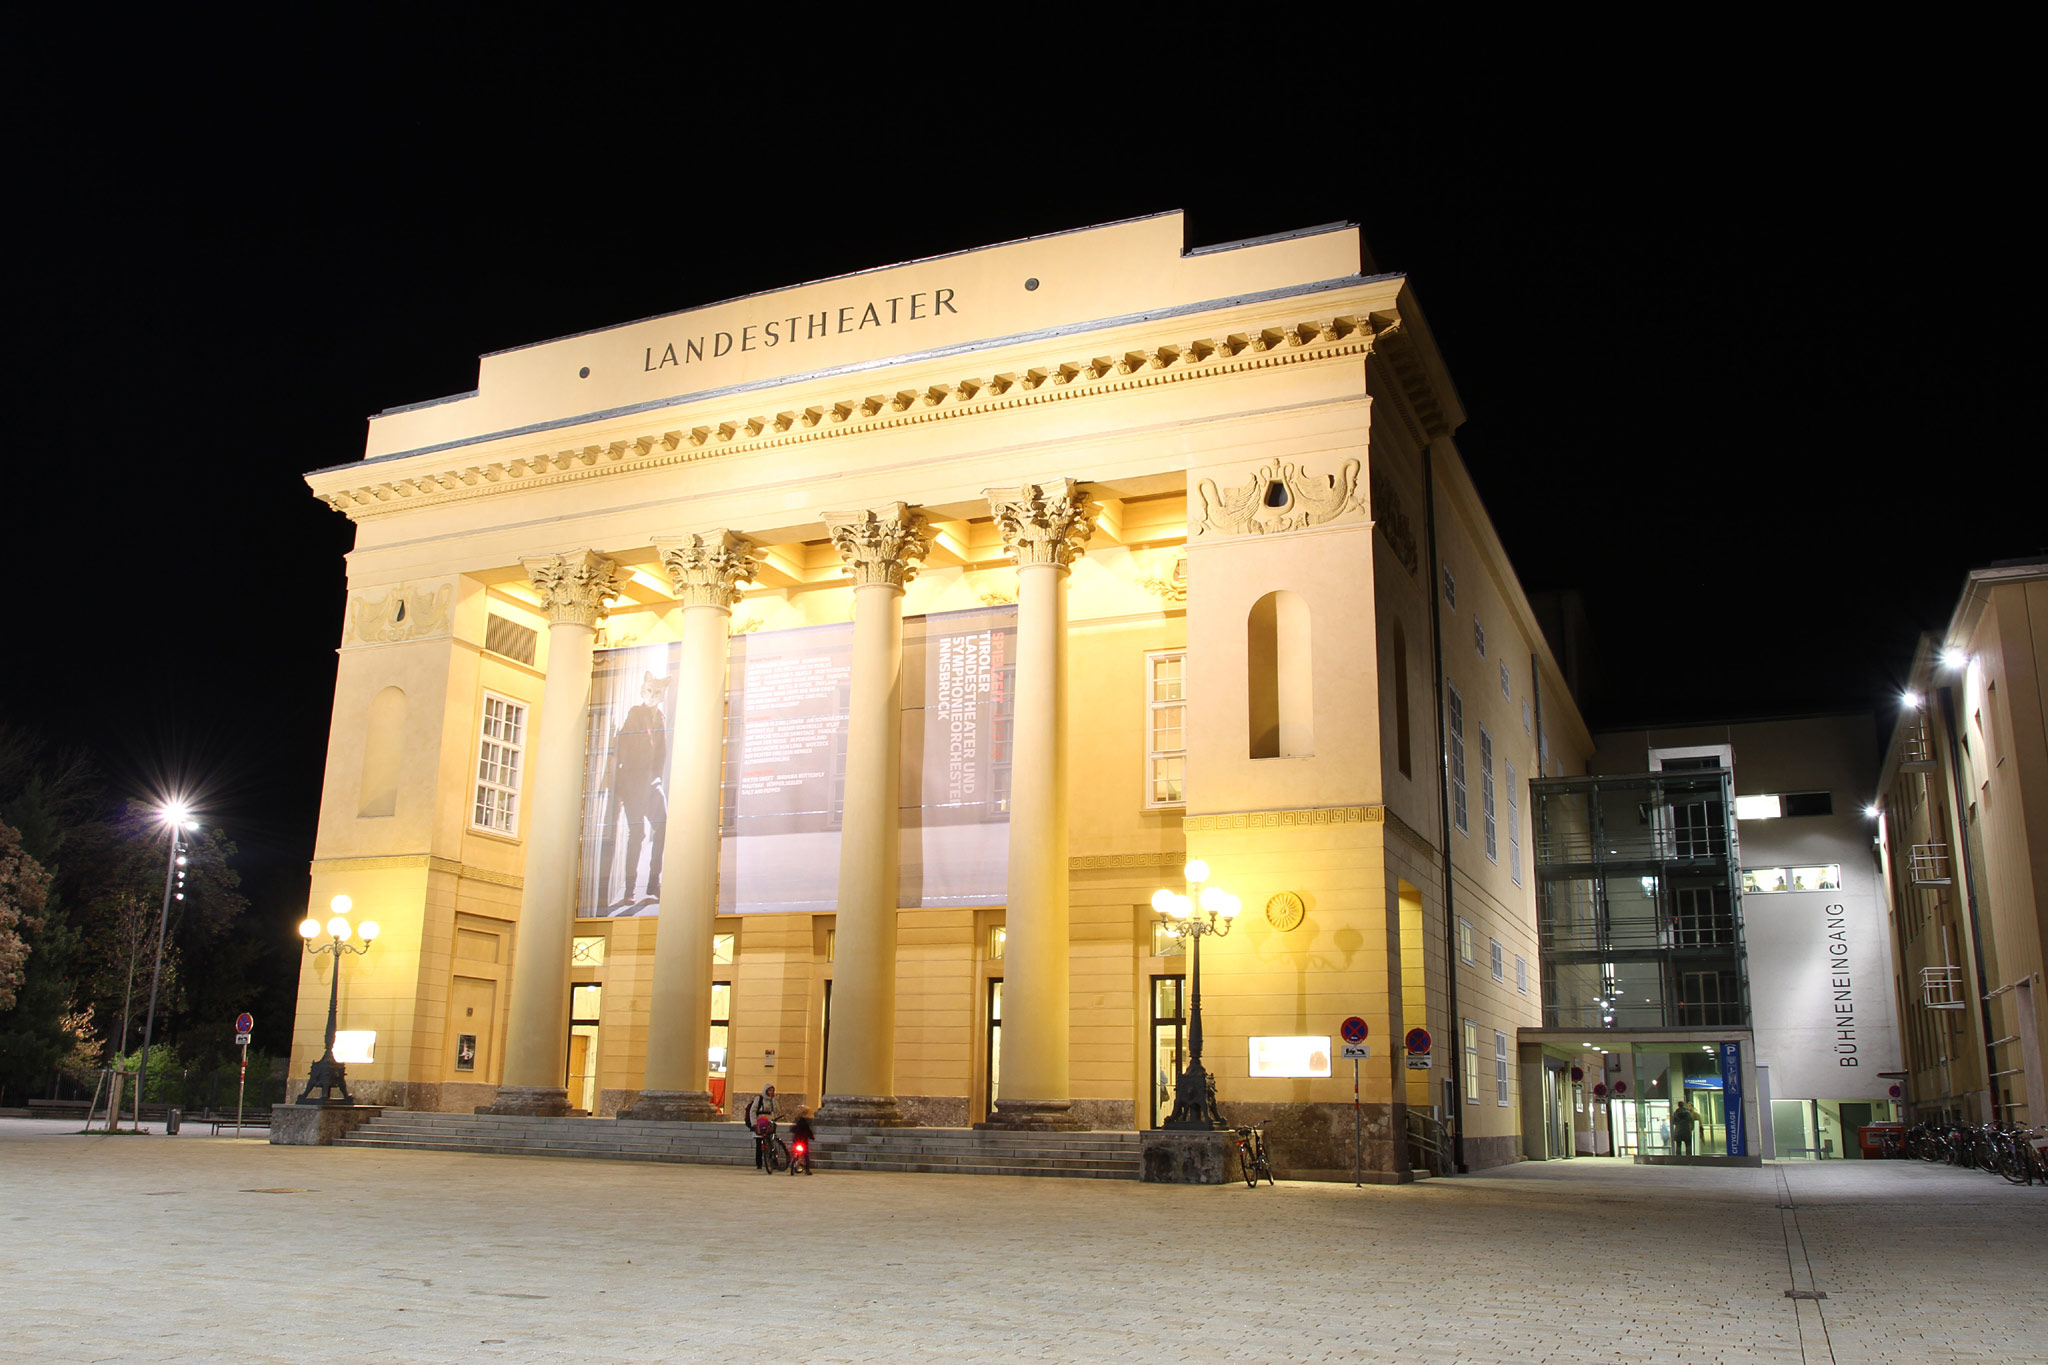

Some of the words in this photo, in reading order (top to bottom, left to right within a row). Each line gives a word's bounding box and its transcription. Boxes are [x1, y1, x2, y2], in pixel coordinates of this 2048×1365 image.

[644, 287, 959, 373] LANDESTHEATER
[938, 637, 951, 721] INNSBRUCK
[963, 635, 978, 758] LANDESTHEATER
[978, 631, 991, 693] TIROLER
[992, 631, 1005, 704] SPIELZEIT
[950, 636, 965, 809] SYMPHONIEORCHESTER
[963, 762, 975, 794] UND
[1825, 904, 1859, 1067] BÜHNENEINGANG
[1727, 1046, 1736, 1055] P
[1729, 1110, 1738, 1154] CITYGARAGE
